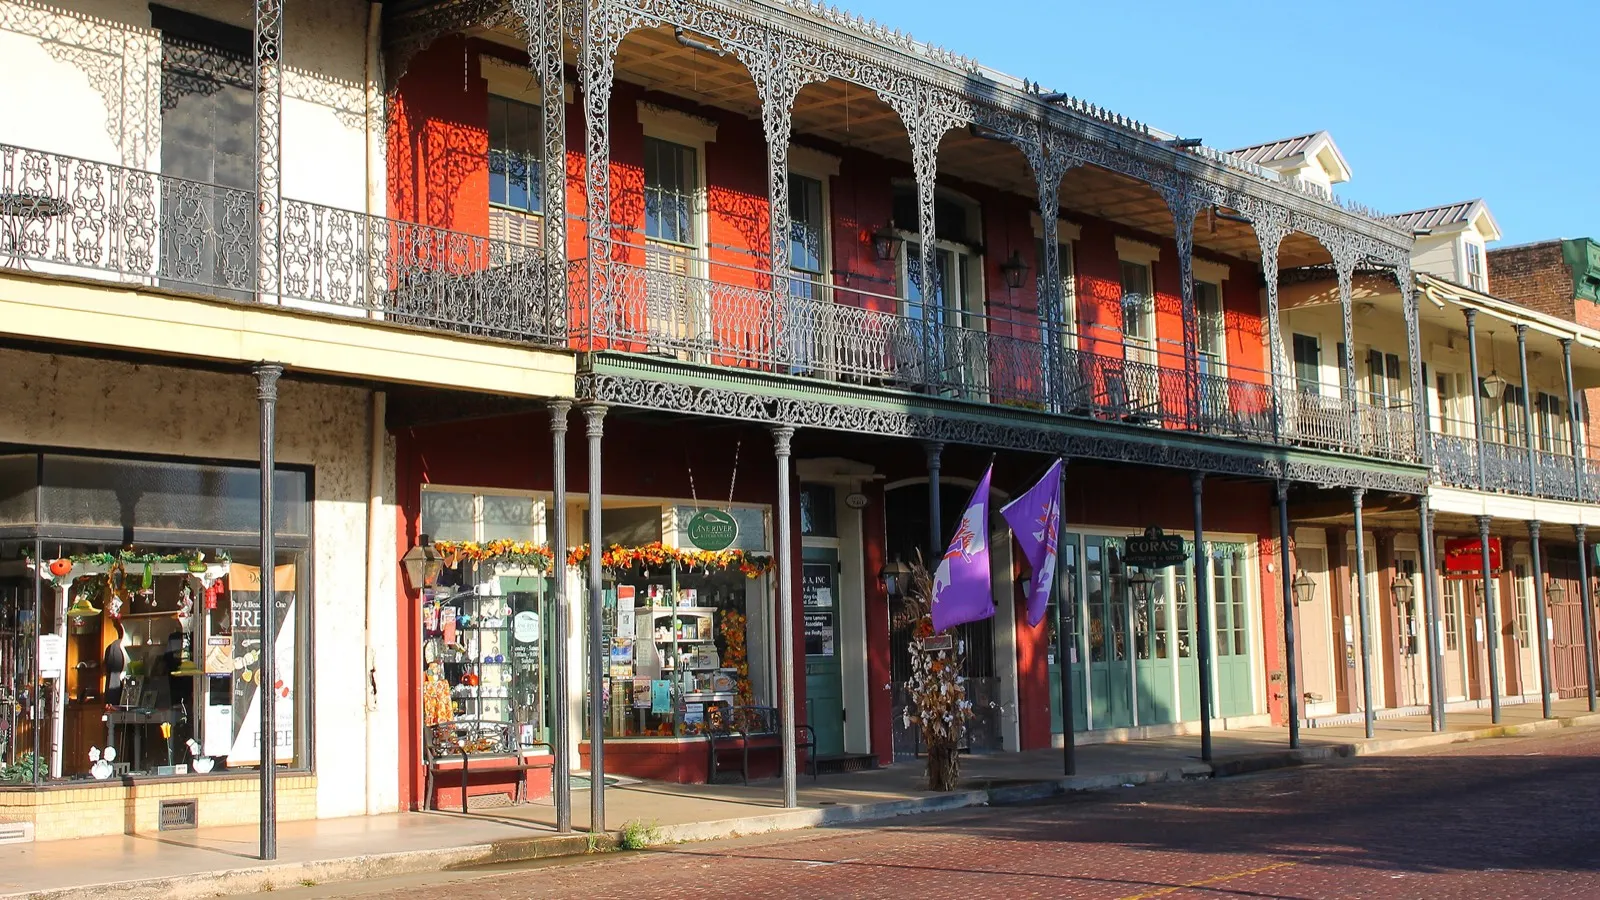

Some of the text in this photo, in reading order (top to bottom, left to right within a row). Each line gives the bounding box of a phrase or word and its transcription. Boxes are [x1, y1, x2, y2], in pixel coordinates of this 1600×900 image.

[1130, 540, 1178, 552] CORA'S
[815, 576, 825, 584] INC
[231, 601, 242, 609] Buy
[231, 610, 261, 627] FRE
